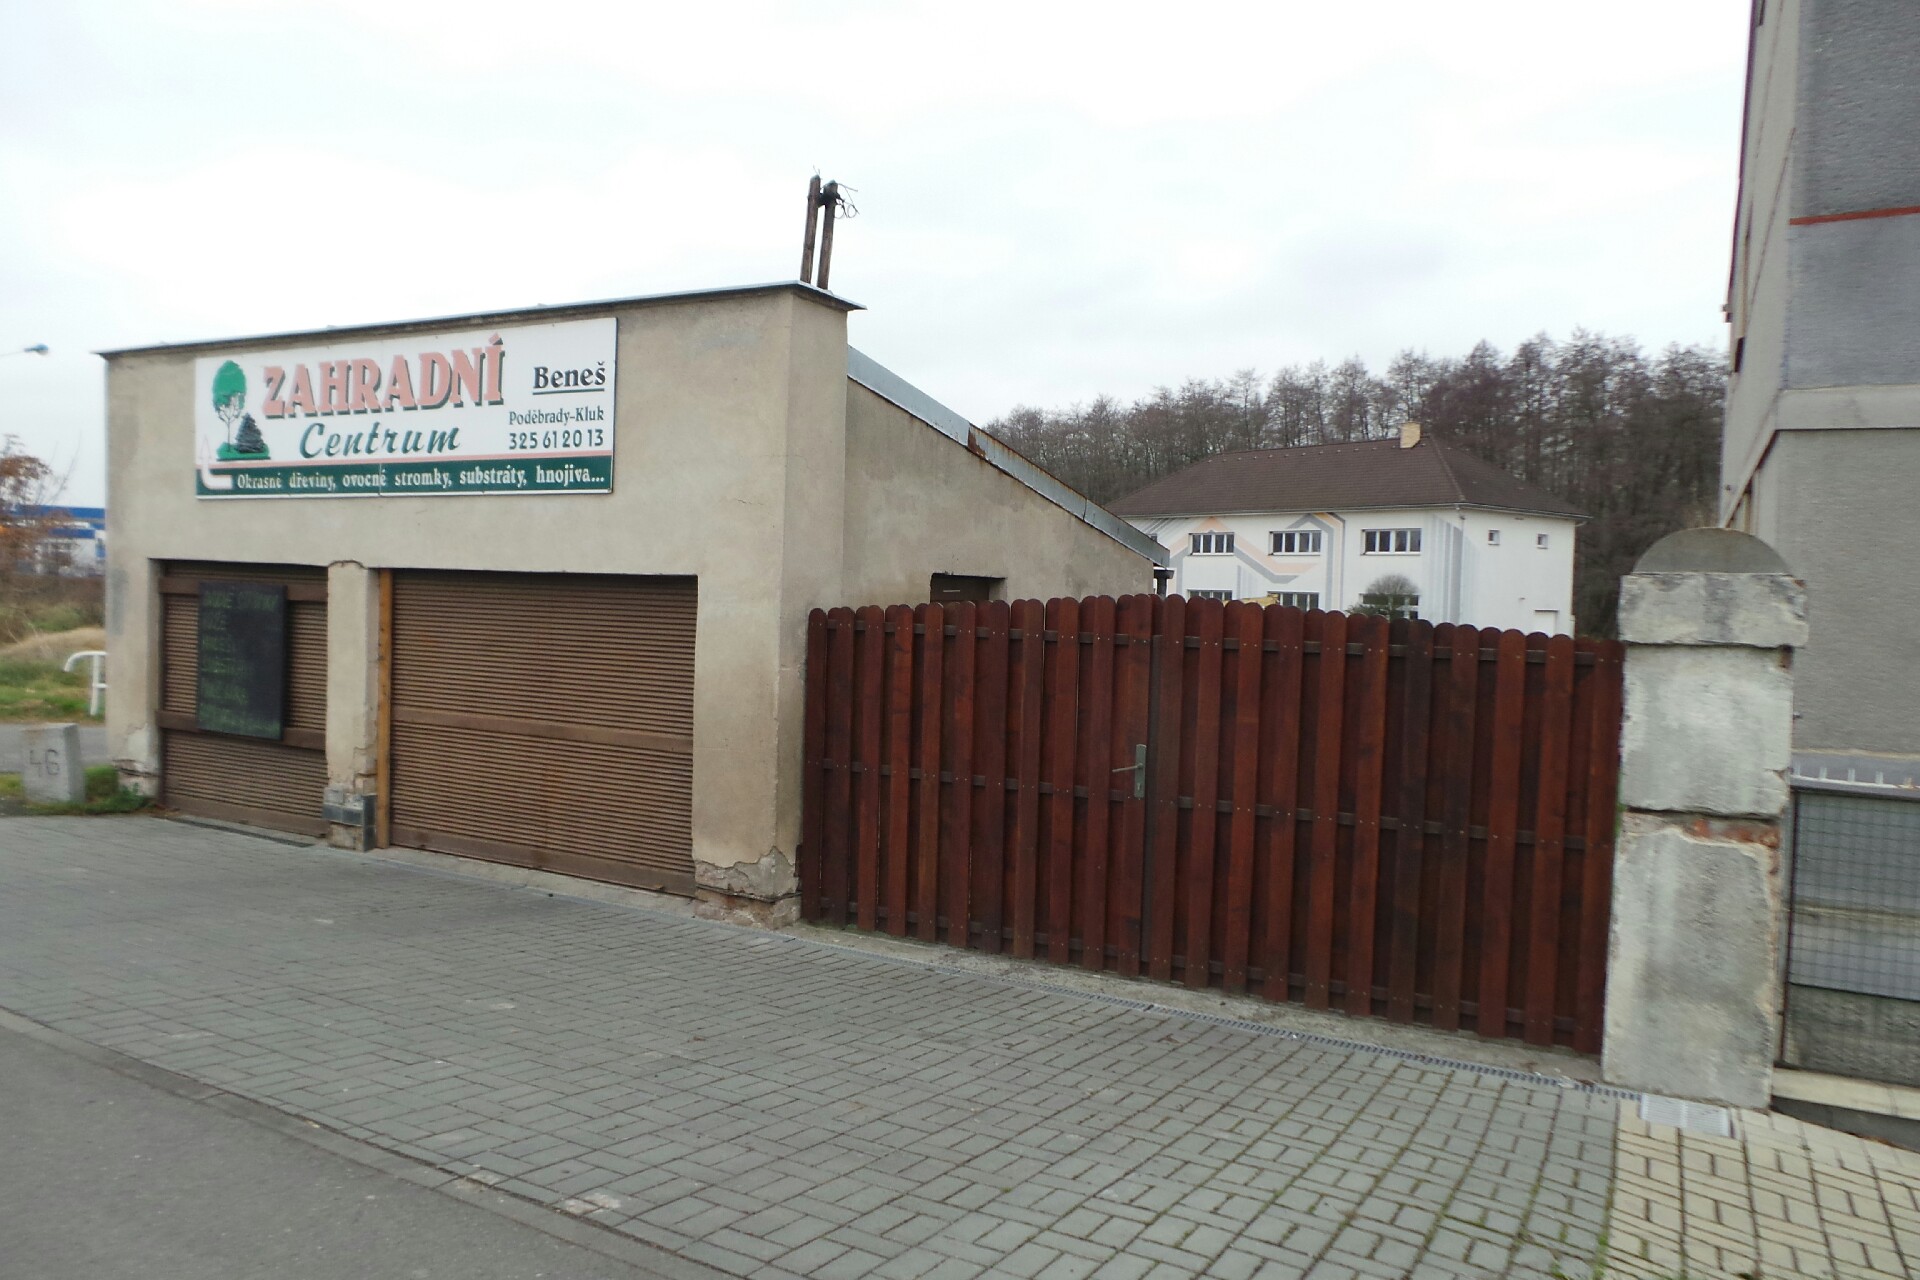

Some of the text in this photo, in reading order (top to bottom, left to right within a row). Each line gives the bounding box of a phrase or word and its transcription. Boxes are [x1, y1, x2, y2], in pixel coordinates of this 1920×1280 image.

[262, 333, 505, 419] ZAHRADNÍ
[533, 361, 606, 389] Beneš
[509, 405, 604, 426] Poděbrady-Kluk
[300, 421, 461, 459] Centrum
[237, 472, 282, 489] Okrasné
[289, 472, 336, 491] dřeviny,
[342, 469, 387, 487] ovocné
[394, 467, 452, 488] stromky,
[459, 464, 527, 488] substráty,
